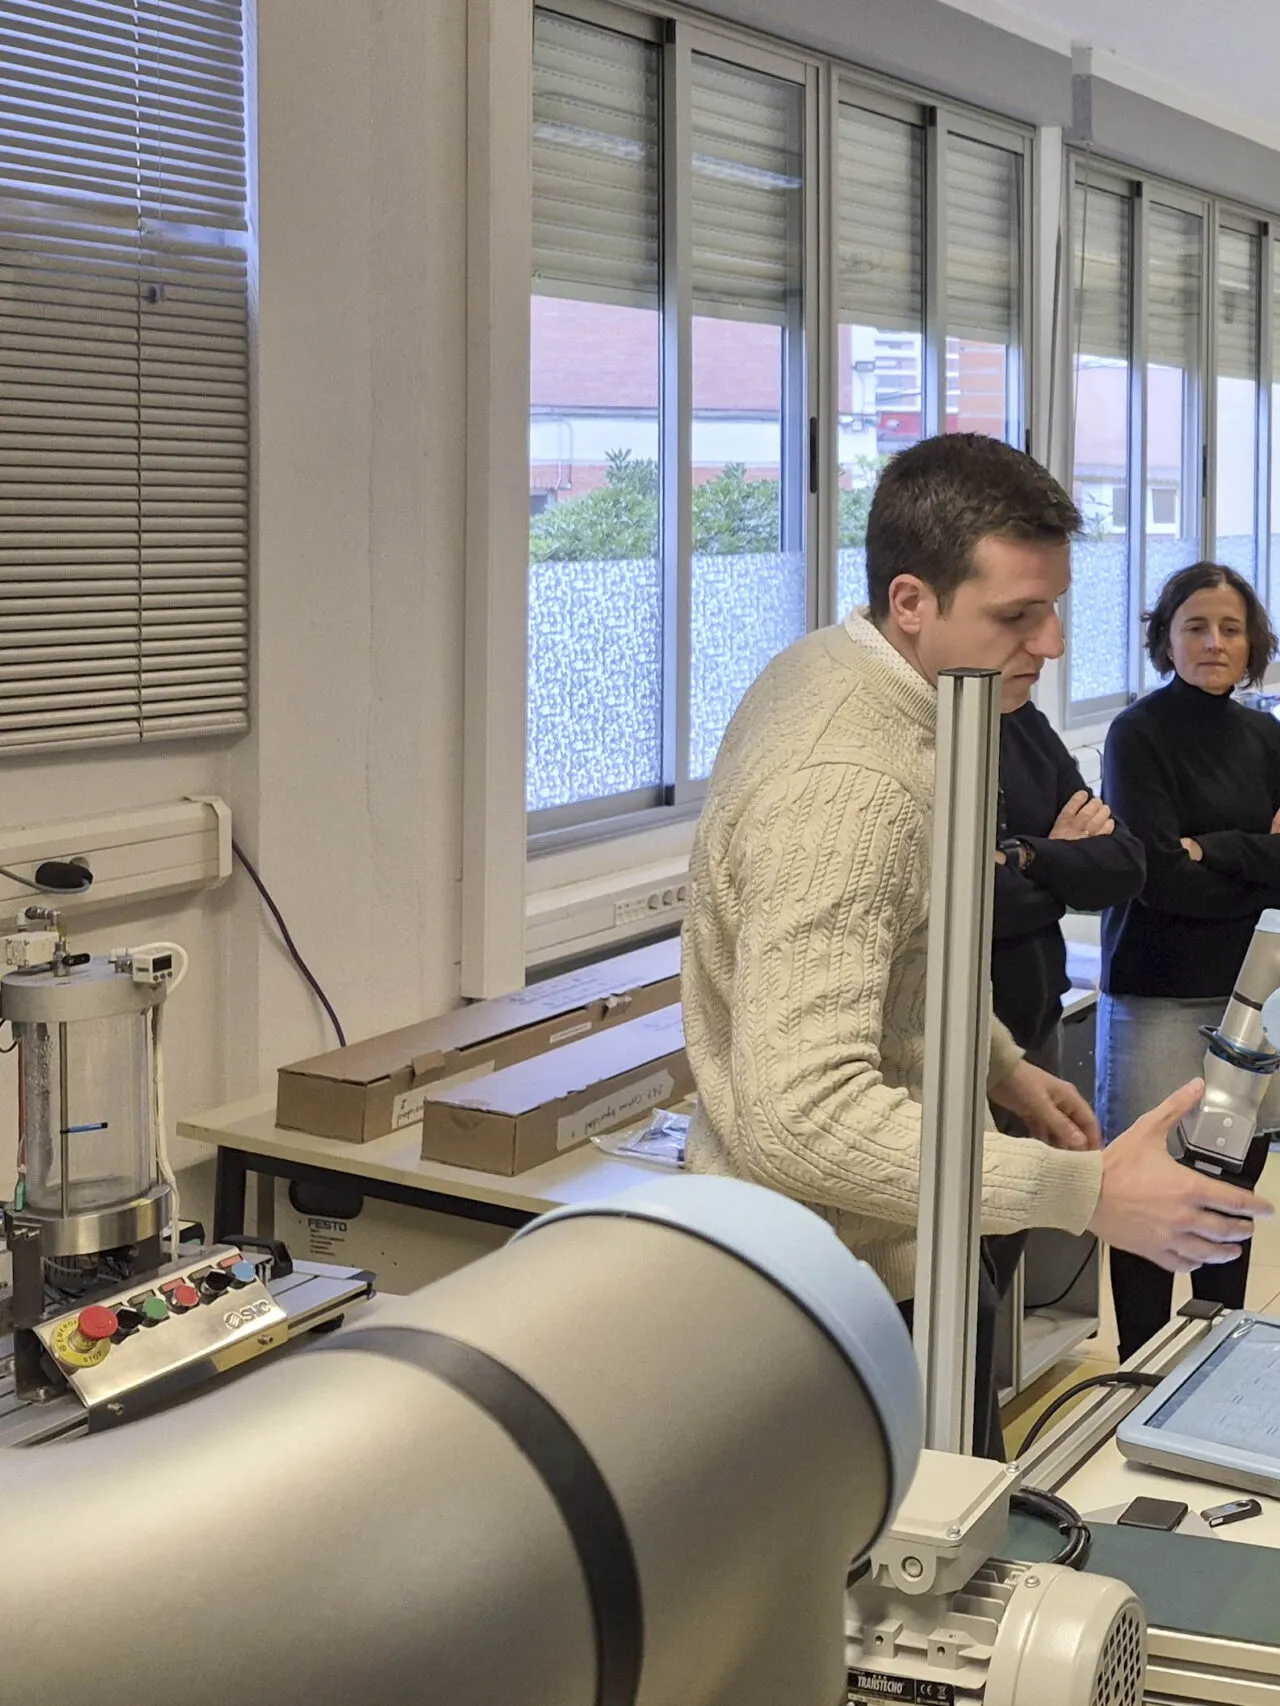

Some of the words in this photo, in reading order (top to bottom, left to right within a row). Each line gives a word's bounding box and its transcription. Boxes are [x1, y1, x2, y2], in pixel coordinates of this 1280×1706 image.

[307, 1218, 348, 1232] FESTO
[83, 1351, 102, 1363] STOP
[920, 1683, 932, 1696] CE
